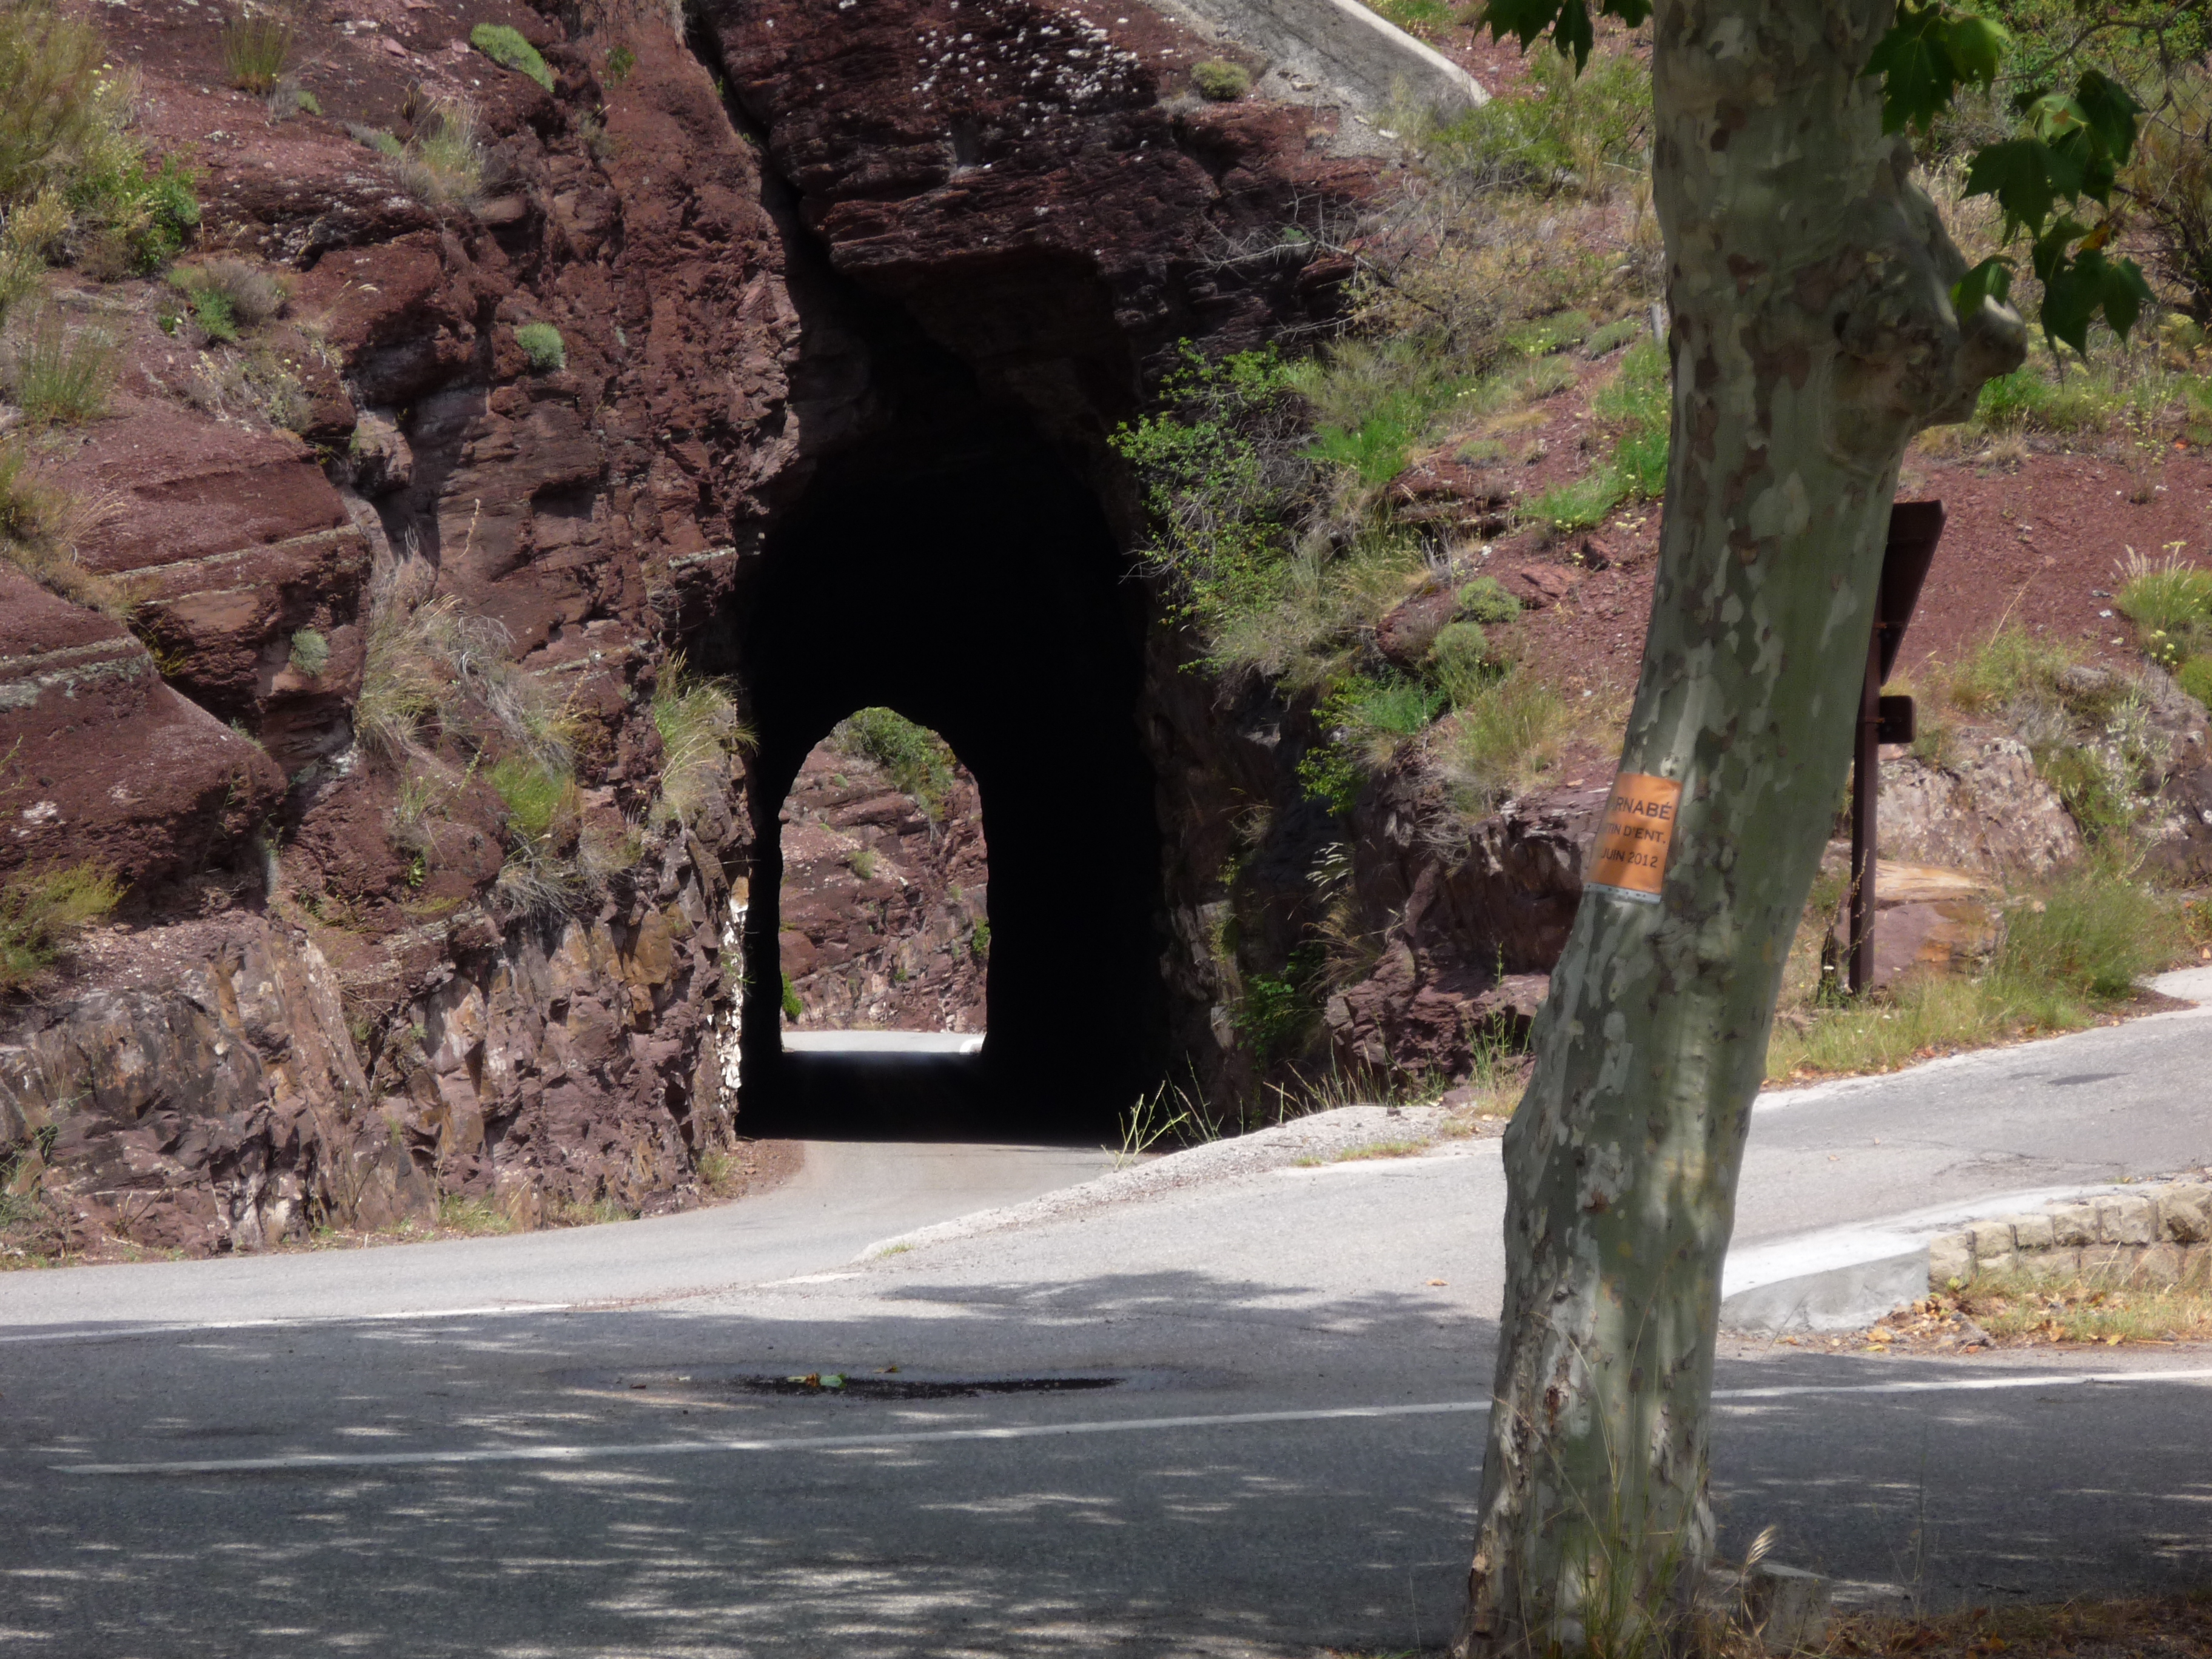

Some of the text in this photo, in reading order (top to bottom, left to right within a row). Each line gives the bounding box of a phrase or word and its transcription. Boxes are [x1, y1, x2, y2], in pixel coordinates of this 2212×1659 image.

[1612, 796, 1672, 820] RNABÉ
[1601, 848, 1658, 868] JUIN 2012
